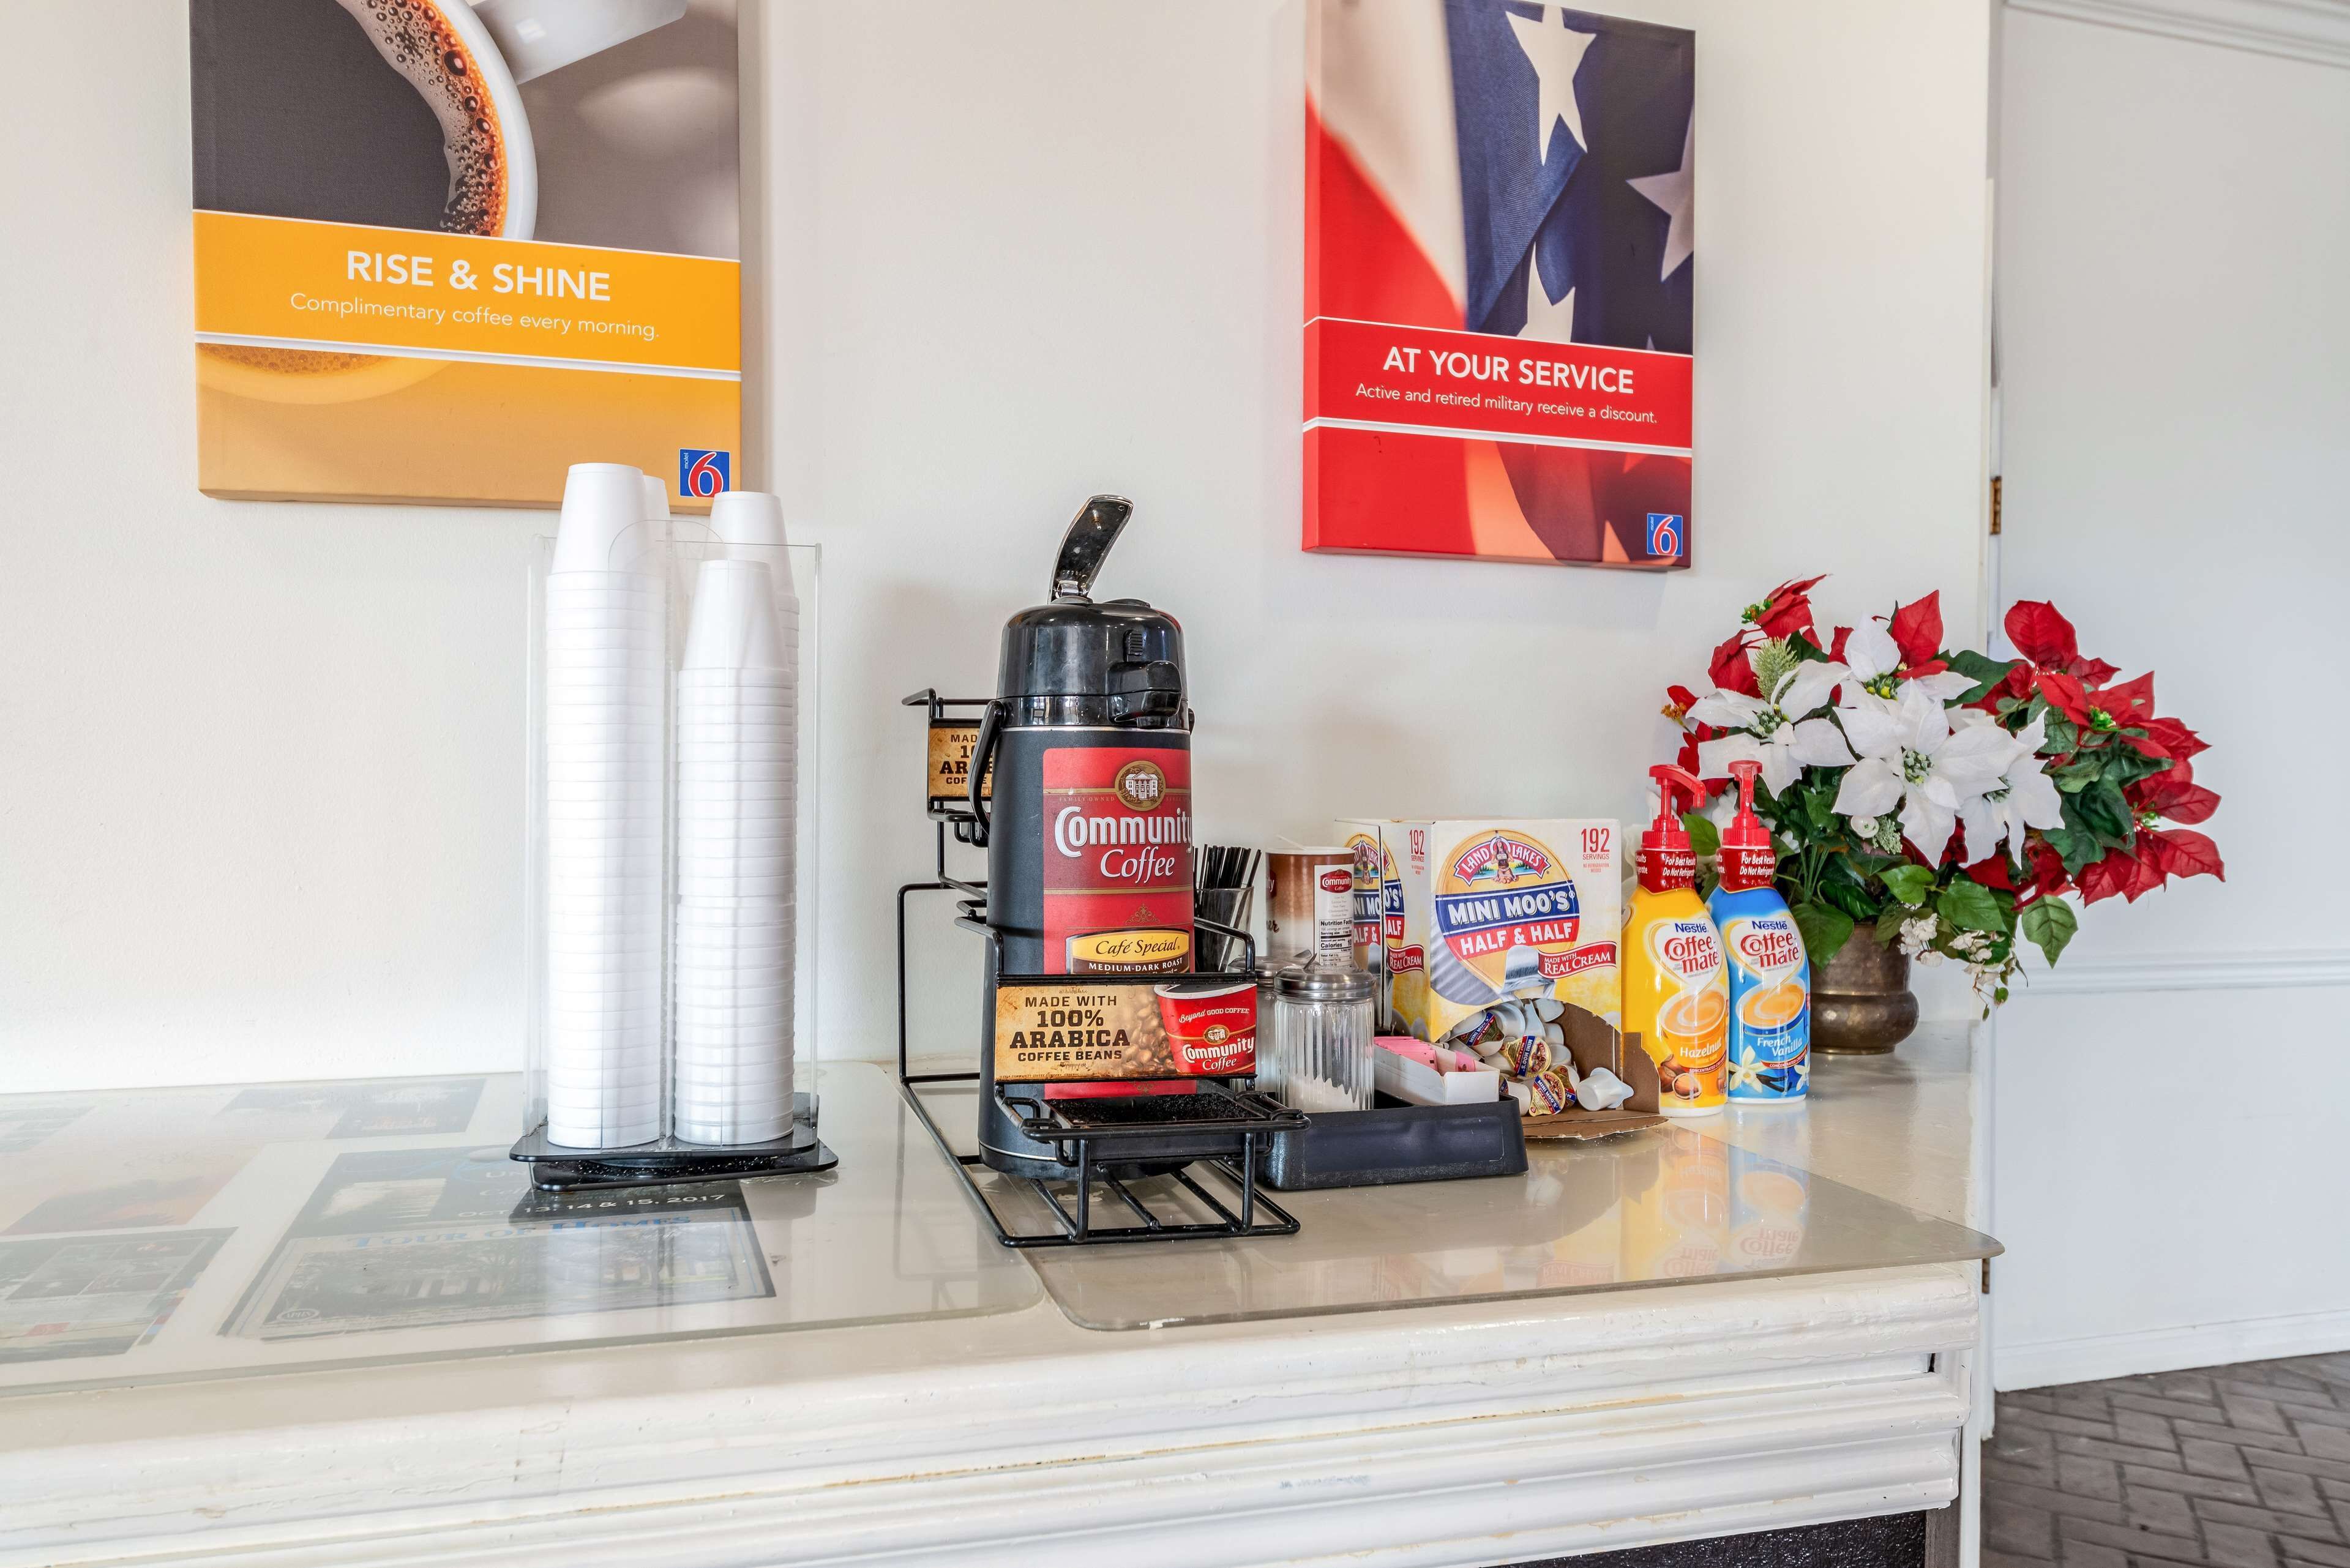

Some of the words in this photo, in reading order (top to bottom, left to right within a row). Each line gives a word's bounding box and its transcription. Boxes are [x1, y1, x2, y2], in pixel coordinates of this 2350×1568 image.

[347, 250, 434, 286] RISE
[449, 260, 479, 291] &
[493, 264, 611, 301] SHINE
[291, 293, 446, 324] Complimentary
[452, 307, 513, 327] coffee
[520, 315, 572, 334] every
[578, 319, 659, 341] morning.
[1383, 346, 1420, 373] AT
[1429, 349, 1509, 382] YOUR
[1518, 359, 1634, 394] SERVICE
[1356, 383, 1400, 400] Active
[1405, 389, 1430, 402] and
[1436, 392, 1480, 407] retired
[1484, 396, 1533, 416] military
[1538, 402, 1584, 417] receive
[1589, 408, 1596, 417] a
[1600, 405, 1657, 423] discount.
[688, 452, 724, 498] 6
[1653, 516, 1678, 556] 6
[1055, 807, 1192, 857] Community
[1581, 828, 1610, 853] 192
[1409, 829, 1424, 855] 192
[1100, 846, 1175, 884] Coffee
[1461, 848, 1490, 873] LAND
[1512, 845, 1541, 867] LAKES
[1665, 856, 1675, 865] For
[1675, 857, 1685, 866] Best
[1742, 854, 1751, 864] For
[1752, 854, 1763, 864] Best
[1663, 867, 1670, 876] Do
[1670, 867, 1678, 876] Not
[1740, 865, 1747, 875] Do
[1748, 866, 1757, 875] Not
[1322, 876, 1352, 887] Community
[1448, 899, 1501, 925] MINI
[1504, 890, 1570, 919] MOO'S
[1354, 927, 1368, 943] ALF
[1372, 926, 1378, 943] &
[1675, 922, 1707, 933] Nestlé
[1752, 920, 1787, 930] Nestlé
[1095, 939, 1132, 957] Café
[1134, 936, 1179, 955] Special
[1461, 930, 1506, 955] HALF
[1514, 928, 1526, 944] &
[1530, 922, 1573, 942] HALF
[1088, 963, 1159, 972] MEDIUM-DARK
[1162, 957, 1183, 969] ROAST
[1390, 956, 1403, 969] REAL
[1404, 955, 1422, 967] CREAM
[1544, 962, 1571, 975] REAL
[1572, 952, 1611, 969] CREAM
[1562, 952, 1576, 961] WITH
[1682, 951, 1719, 973] mate
[1759, 947, 1799, 968] mate
[1025, 996, 1070, 1007] MADE
[1077, 996, 1117, 1006] WITH
[1037, 1009, 1104, 1028] 100%
[1179, 1009, 1206, 1023] Beyond
[1009, 1029, 1130, 1048] ARABICA
[1680, 1036, 1721, 1058] Hazelnut
[1757, 1032, 1791, 1047] French
[1772, 1037, 1802, 1056] Vanilla
[1018, 1051, 1070, 1061] COFFEE
[1076, 1050, 1122, 1060] BEANS
[1182, 1037, 1254, 1063] Community
[1202, 1056, 1237, 1071] Coffee
[1521, 1051, 1530, 1070] MOO'S
[1537, 1079, 1546, 1092] MINI
[1545, 1091, 1557, 1107] MOO'S
[667, 1195, 725, 1203] 2017
